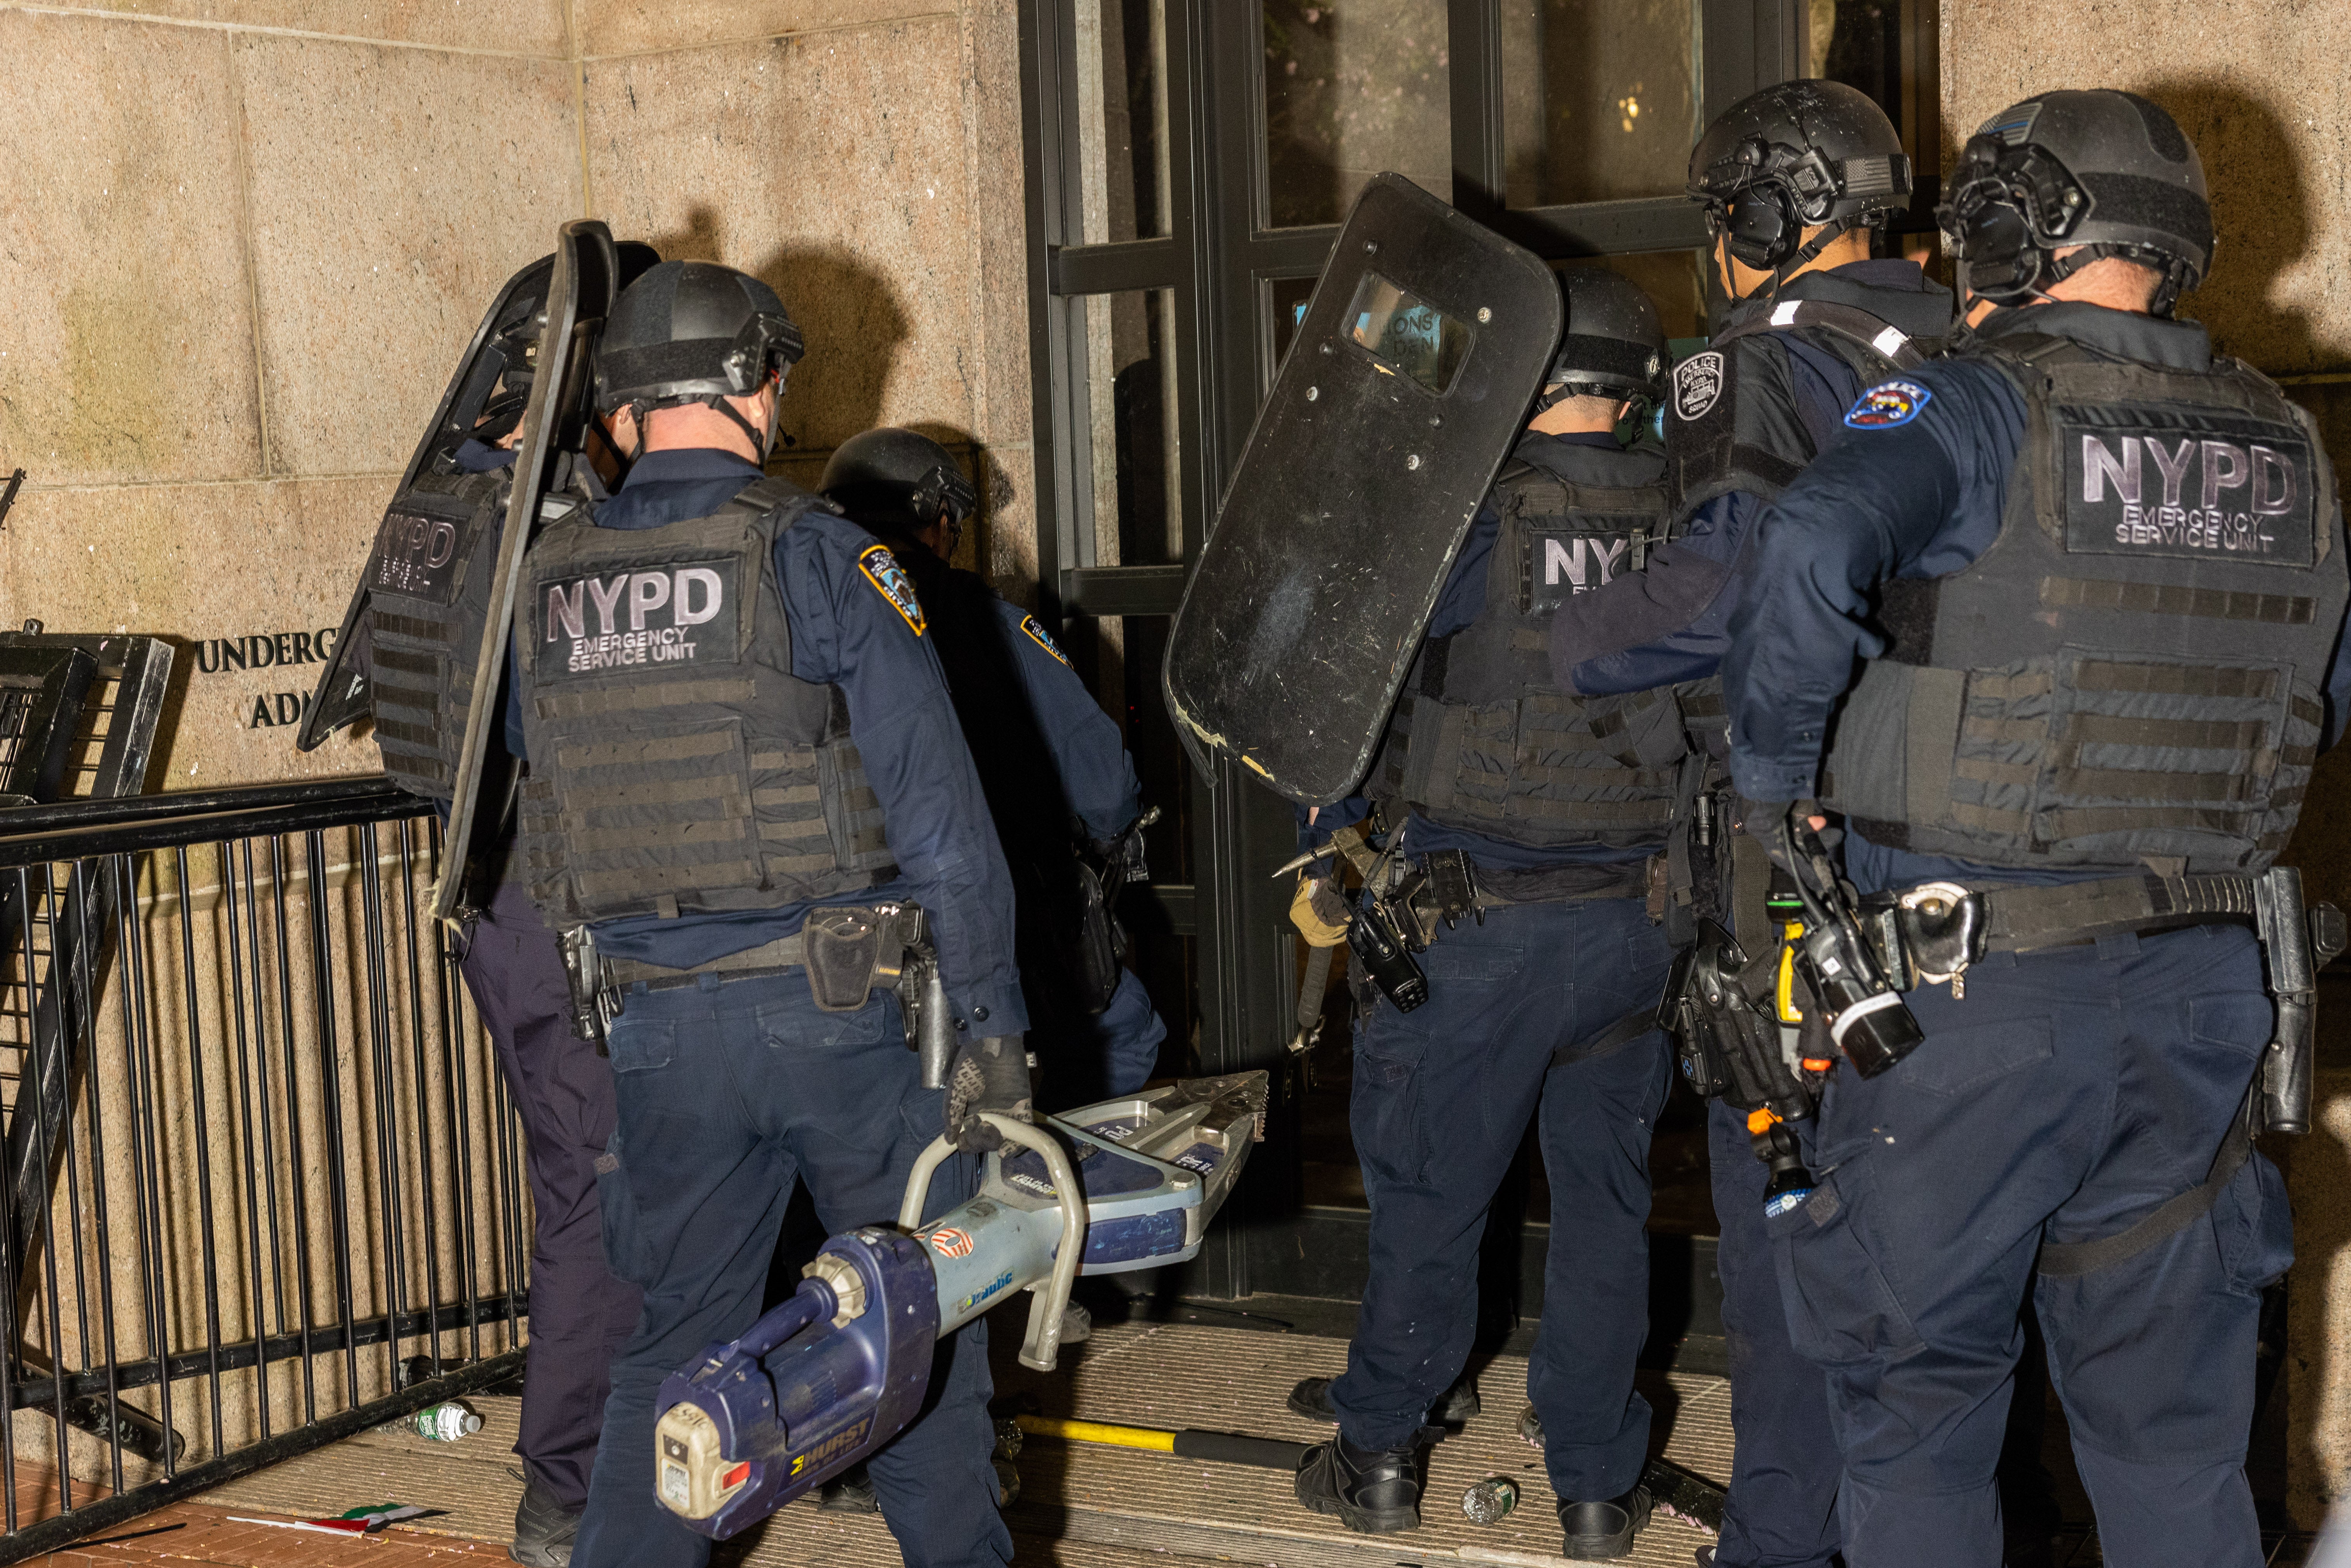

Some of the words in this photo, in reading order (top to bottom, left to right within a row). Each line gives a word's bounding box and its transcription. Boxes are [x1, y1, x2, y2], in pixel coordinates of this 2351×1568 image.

[1681, 356, 1716, 381] POLICE
[2083, 435, 2297, 515] NYPD
[2123, 504, 2265, 533] EMERGENCY
[2116, 524, 2218, 549] SERVICE
[2224, 530, 2274, 553] UNIT
[547, 568, 722, 642] NYPD
[195, 627, 340, 673] UNDERG
[572, 626, 689, 656] EMERGENCY
[568, 647, 647, 672] SERVICE
[652, 642, 696, 661] UNIT
[803, 1418, 870, 1465] HURST
